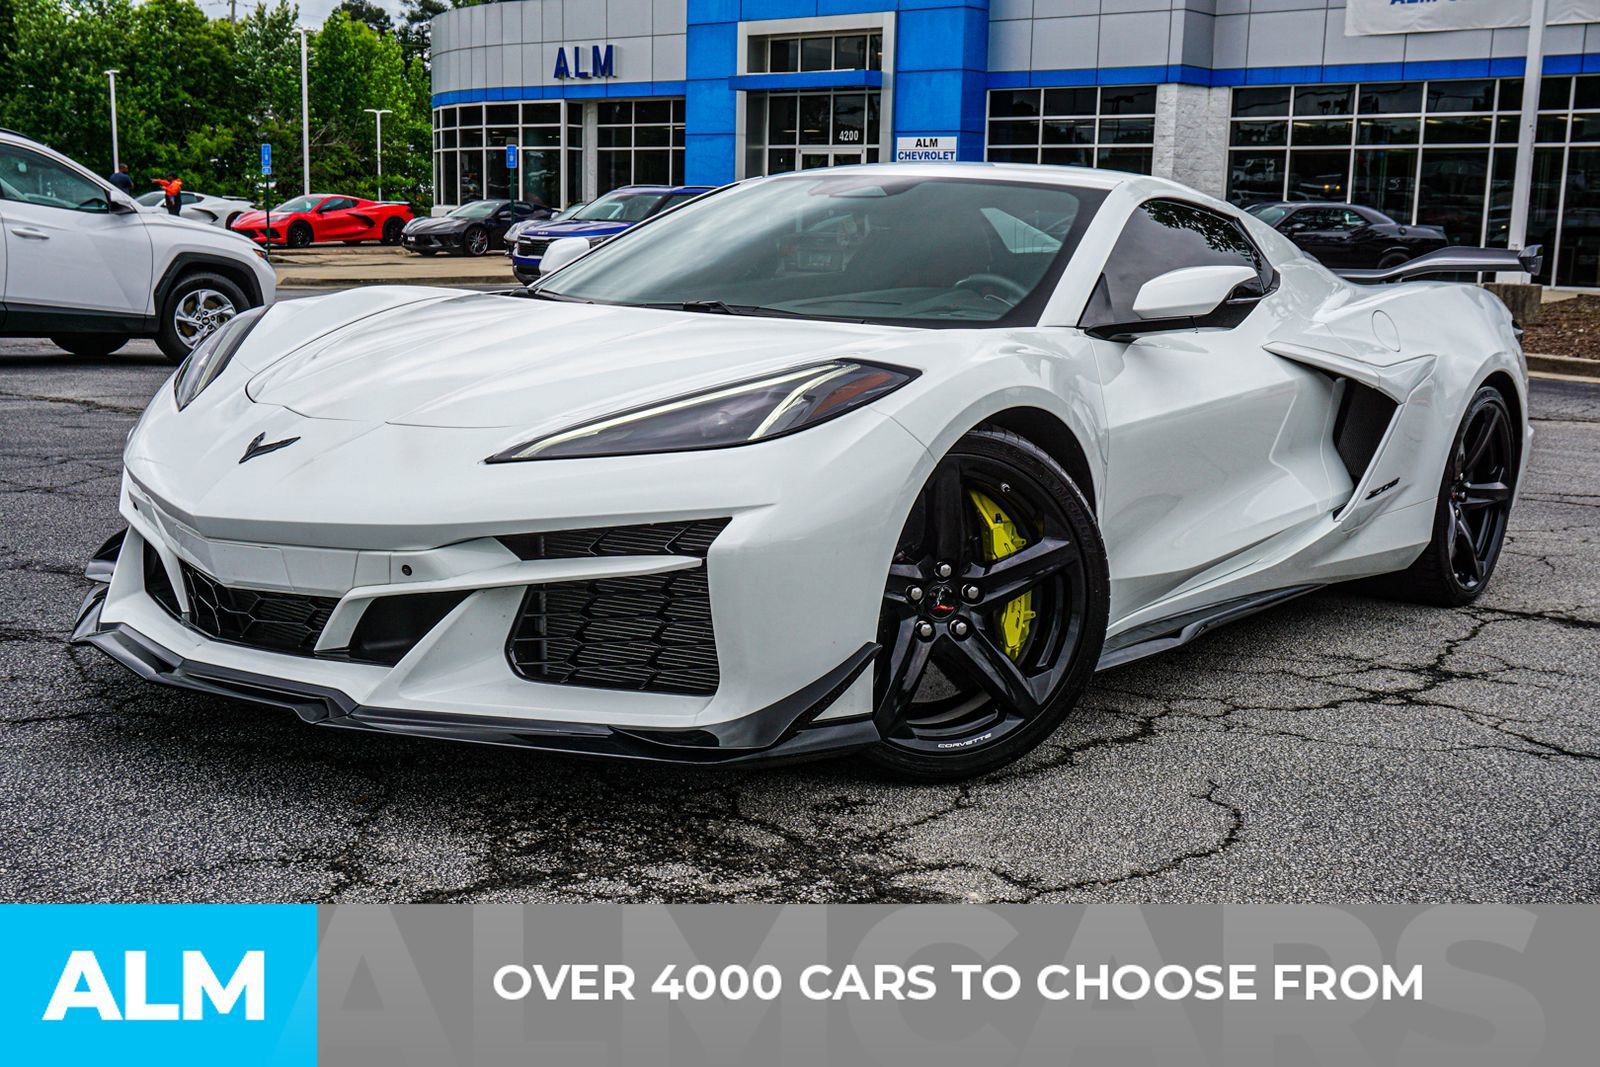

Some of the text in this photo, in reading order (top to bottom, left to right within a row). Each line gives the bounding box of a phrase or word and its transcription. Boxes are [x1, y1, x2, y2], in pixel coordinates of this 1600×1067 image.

[553, 44, 616, 79] ALM
[839, 130, 859, 141] 4200
[915, 138, 938, 148] ALM
[898, 151, 956, 160] CHEVROLET
[937, 732, 992, 749] CORVETTE
